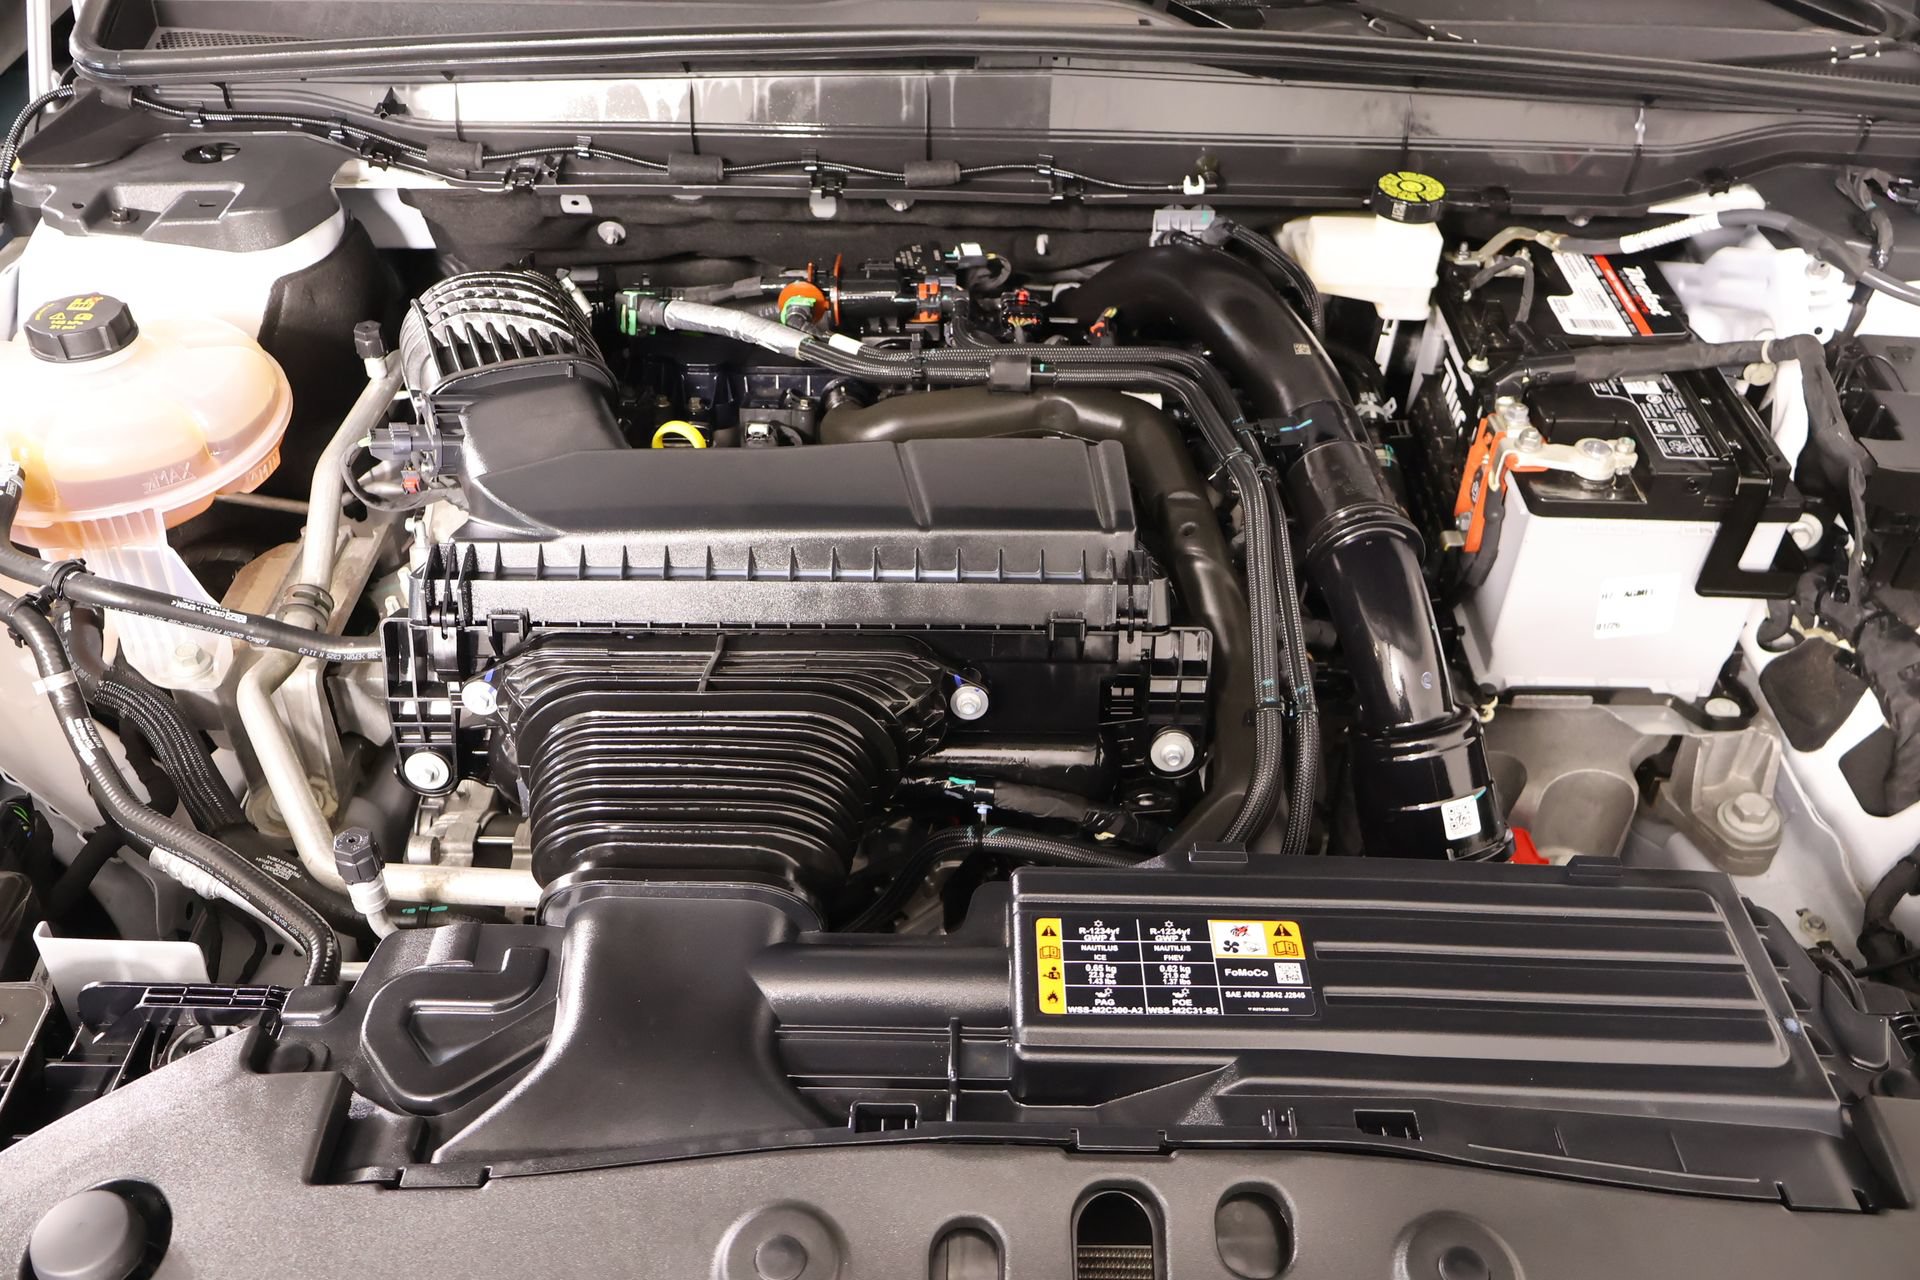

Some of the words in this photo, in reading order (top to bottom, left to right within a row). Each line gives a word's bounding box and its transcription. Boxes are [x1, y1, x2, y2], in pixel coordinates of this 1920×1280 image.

[1622, 265, 1672, 317] Duralast
[1078, 927, 1120, 935] R-1234yf
[1149, 928, 1191, 936] R-1234yf
[1083, 934, 1108, 942] GWP
[1081, 944, 1119, 952] NAUTILUS
[1105, 964, 1117, 974] kg
[1179, 965, 1192, 975] kg
[1224, 968, 1269, 977] FoMoCo
[1261, 991, 1283, 999] J2842
[1094, 998, 1115, 1006] PAG
[1067, 1006, 1144, 1014] WSS-M2C300-A2
[1148, 1006, 1219, 1014] WSS-M2C31-B2
